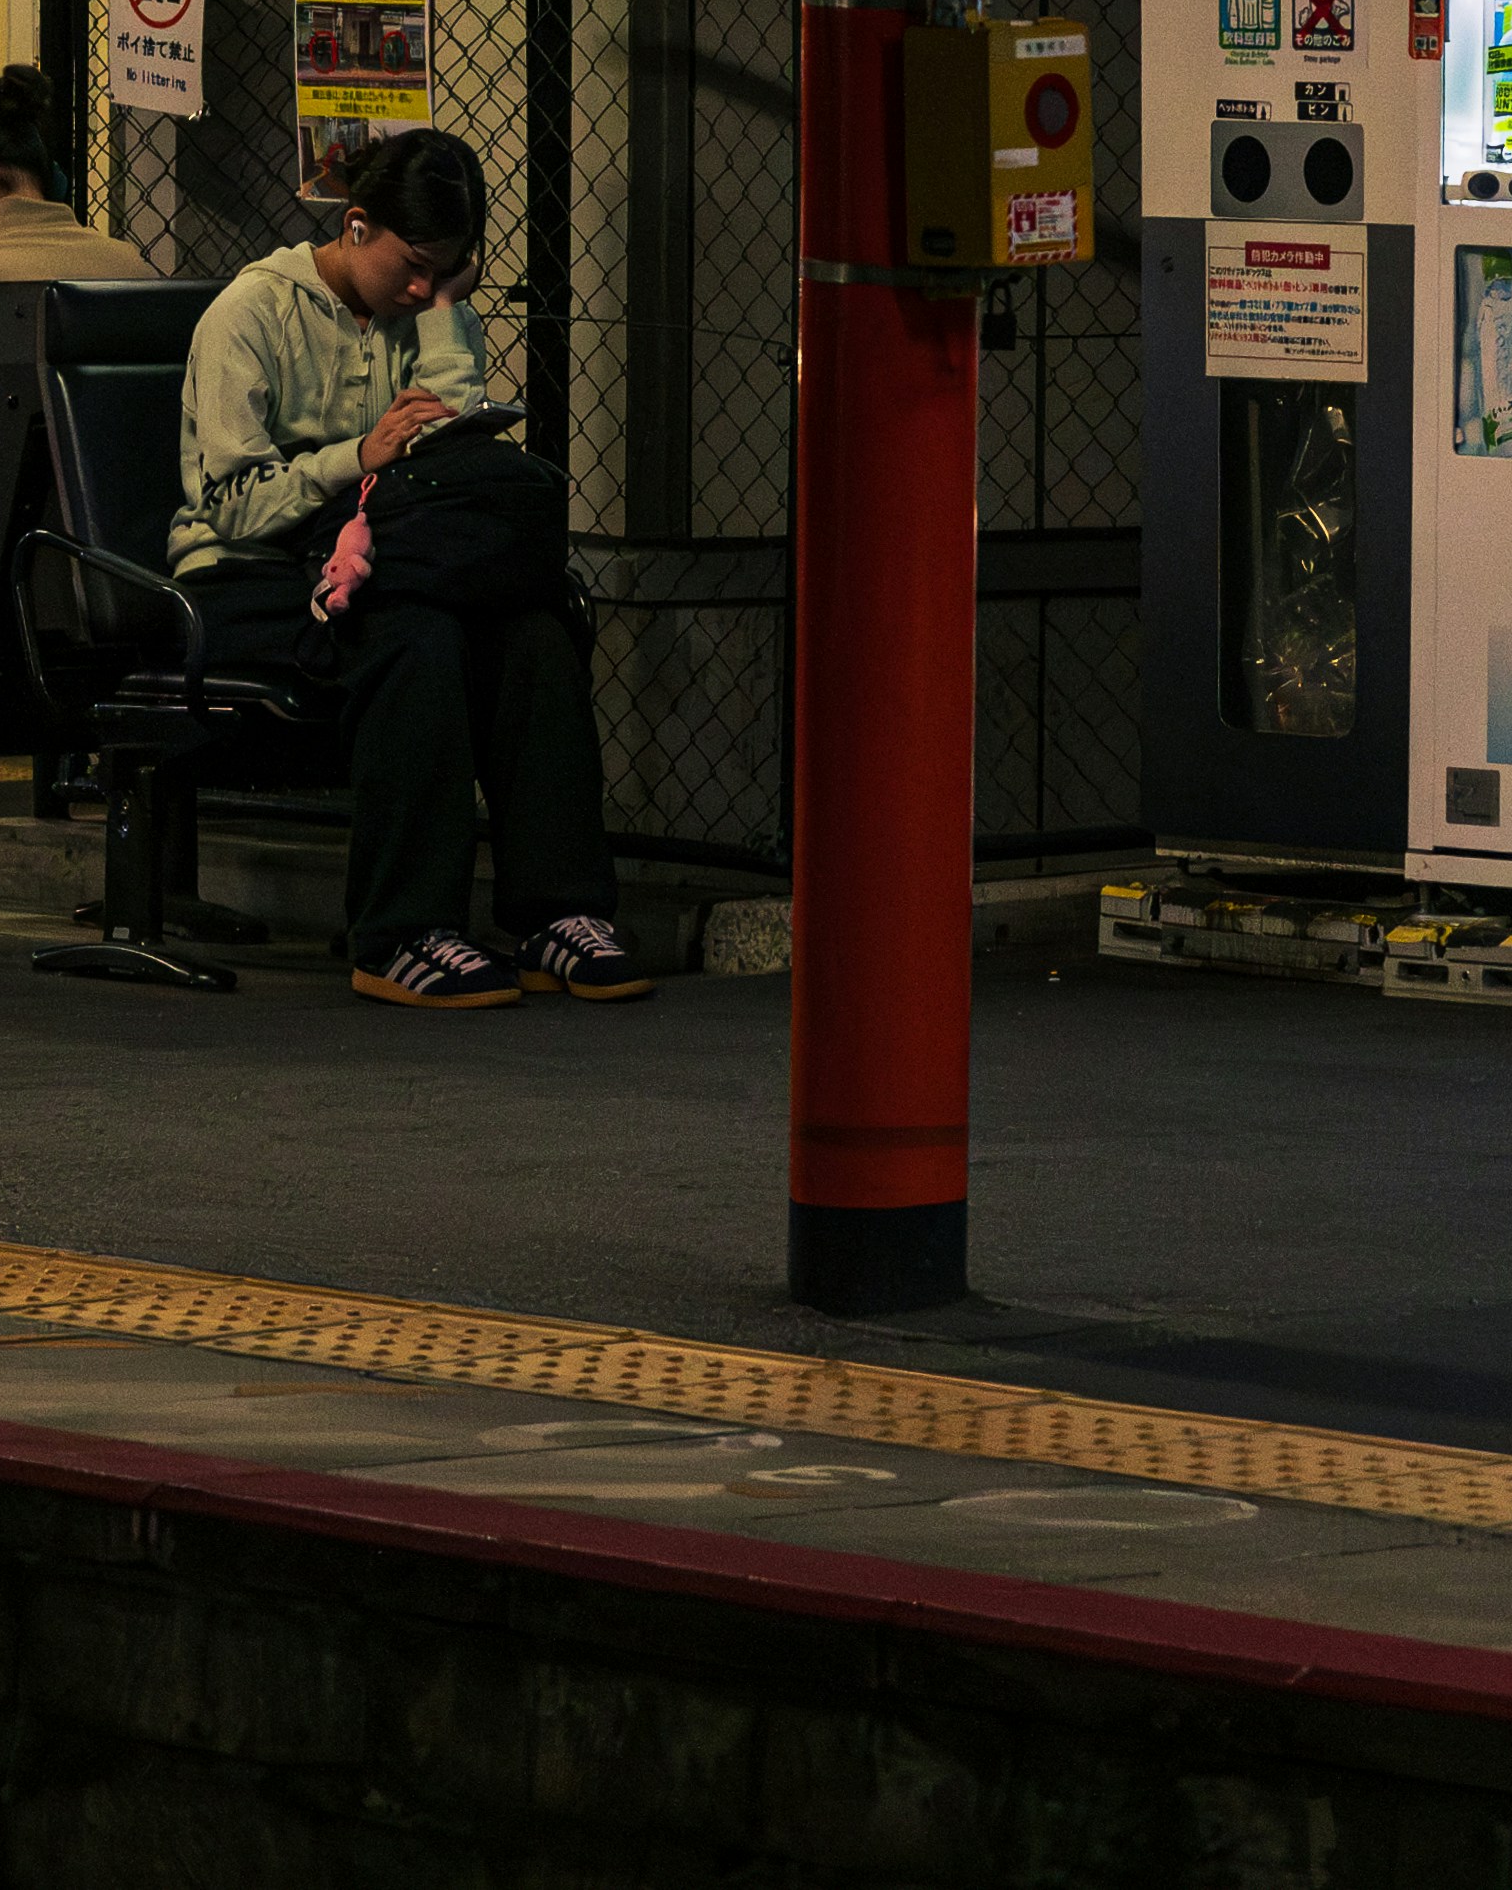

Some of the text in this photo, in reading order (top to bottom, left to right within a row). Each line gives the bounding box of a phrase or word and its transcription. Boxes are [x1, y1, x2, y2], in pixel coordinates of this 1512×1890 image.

[117, 32, 195, 63] ポイ捨て禁止
[127, 67, 187, 92] No littering
[1305, 84, 1326, 95] カン
